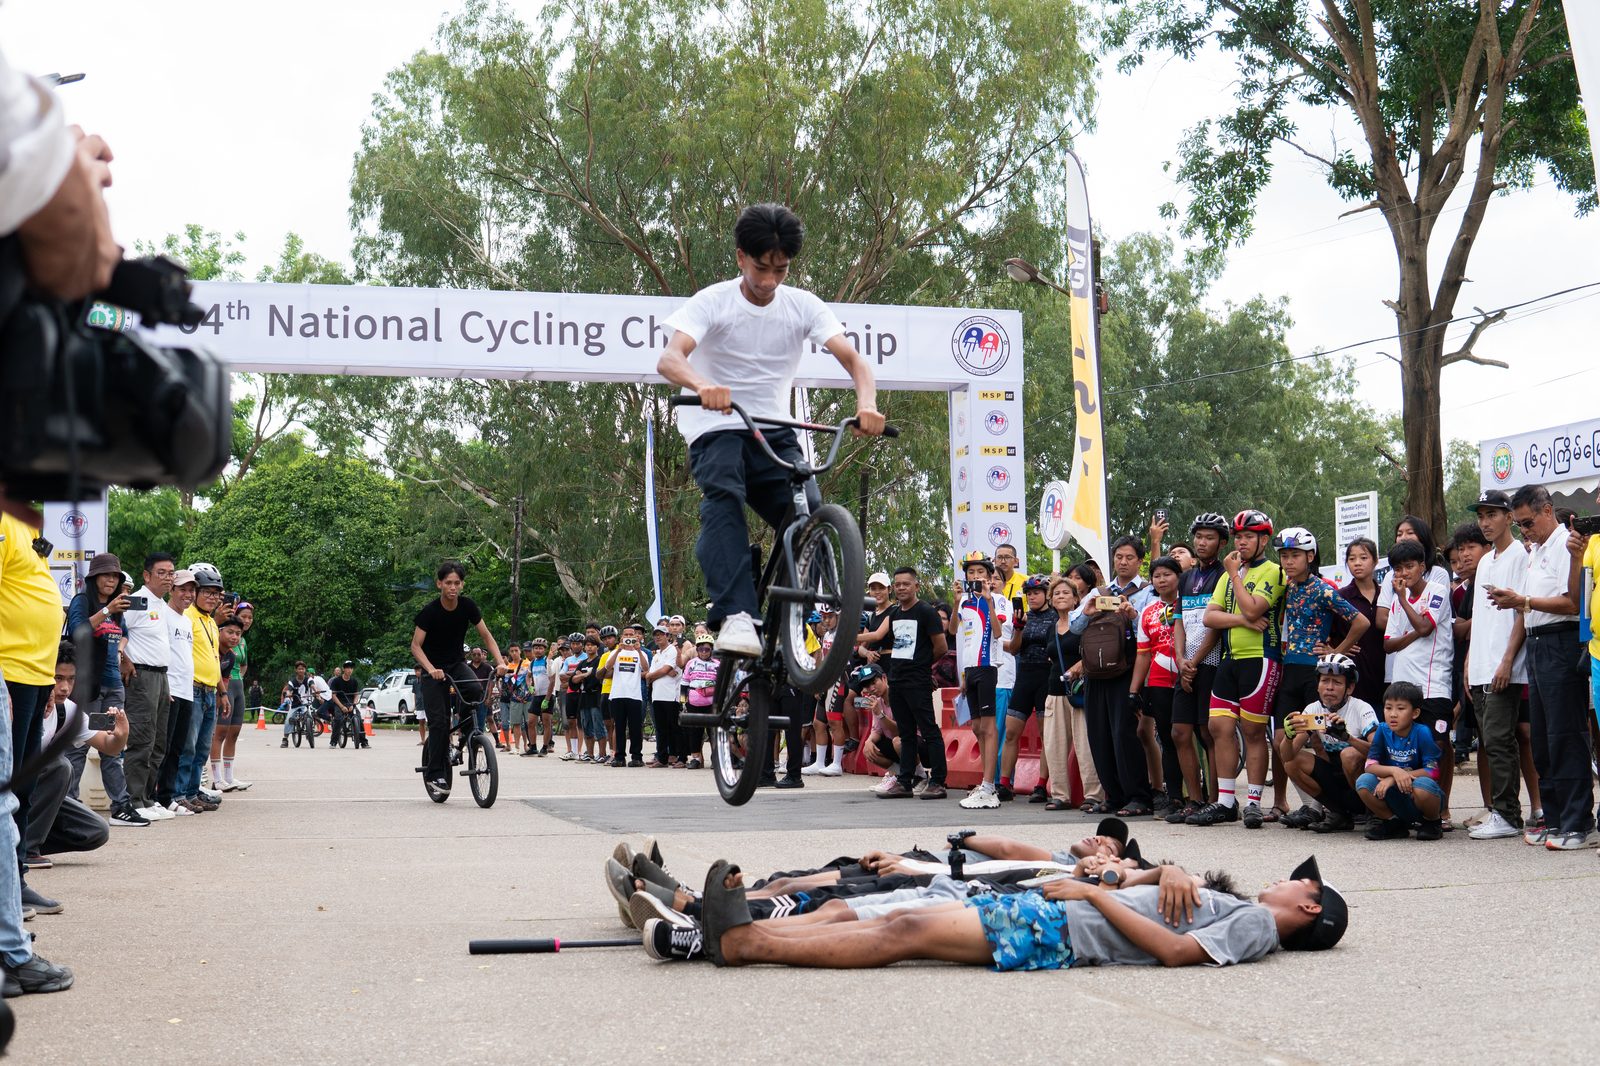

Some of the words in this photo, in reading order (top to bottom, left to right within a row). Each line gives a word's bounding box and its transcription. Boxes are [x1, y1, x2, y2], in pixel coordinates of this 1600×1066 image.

[269, 305, 442, 343] National
[460, 310, 605, 356] Cycling
[1268, 613, 1277, 647] younglife
